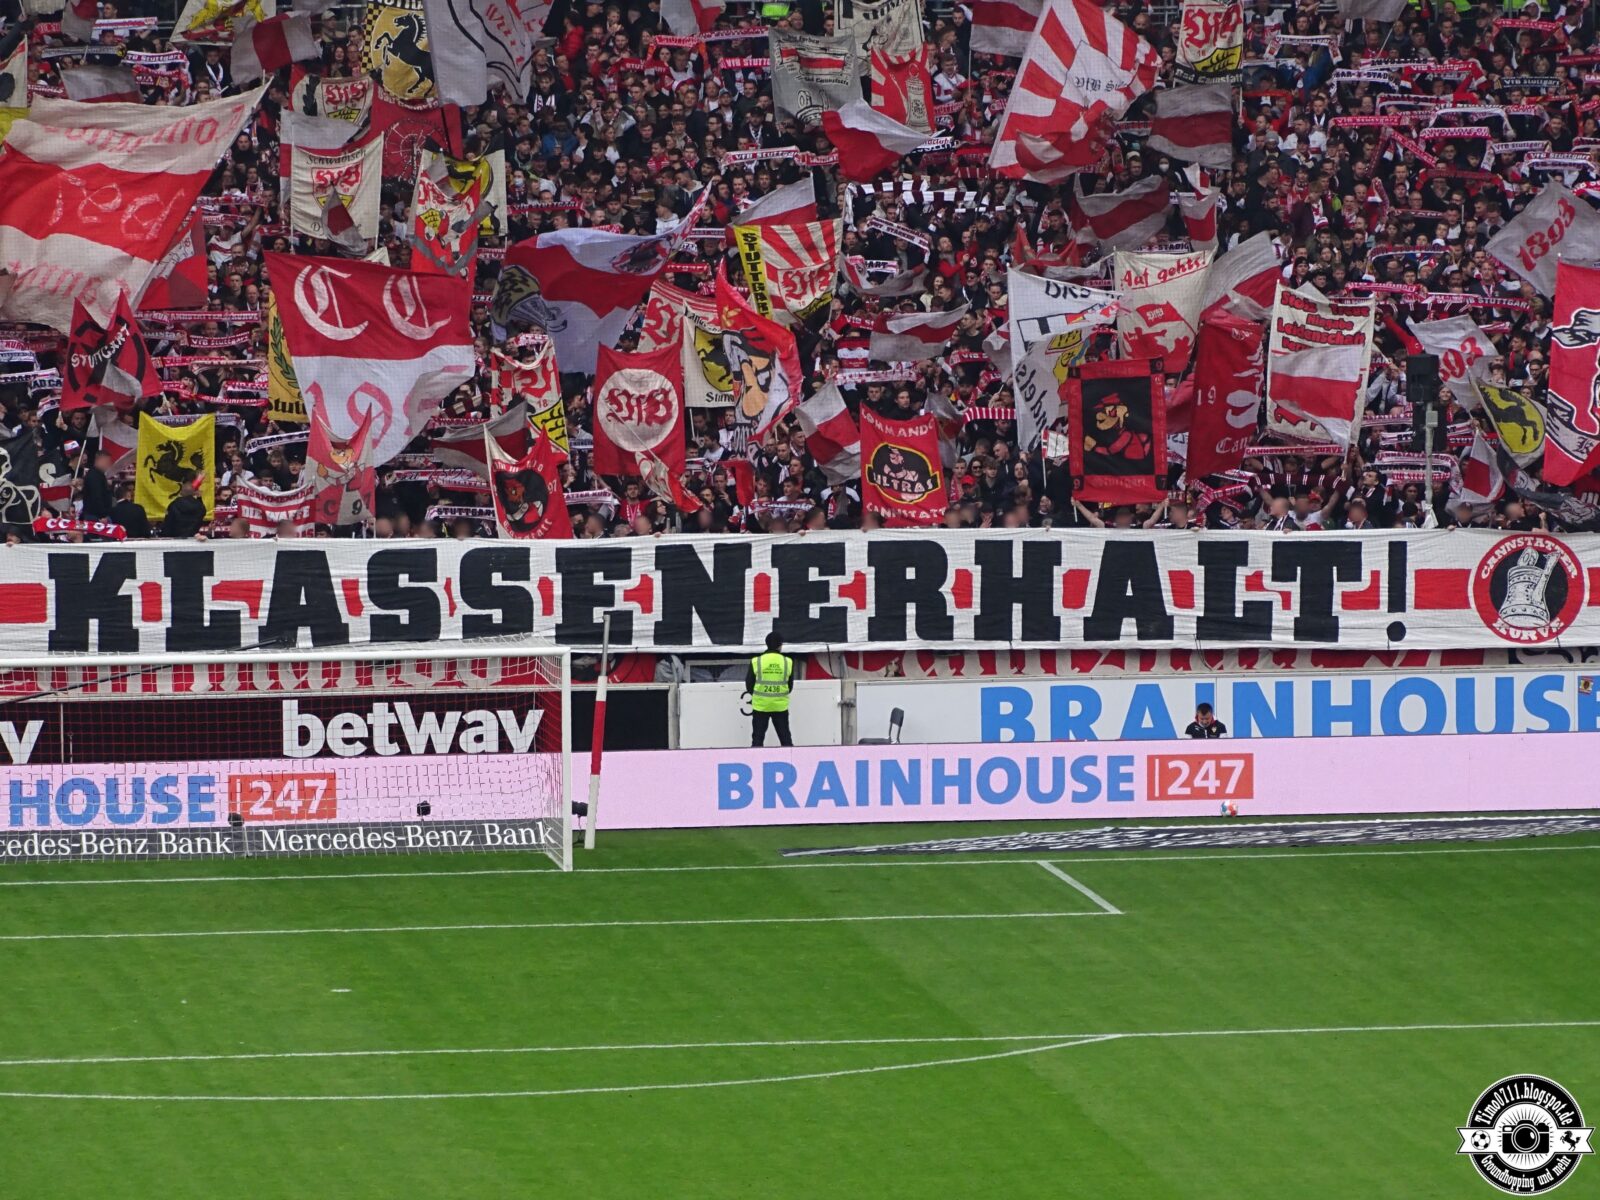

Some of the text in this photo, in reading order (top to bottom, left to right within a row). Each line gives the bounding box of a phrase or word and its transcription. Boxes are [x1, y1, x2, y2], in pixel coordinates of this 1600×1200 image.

[1522, 78, 1560, 88] Stuttgart
[1122, 250, 1207, 288] Auf gehts!
[1276, 317, 1367, 346] Leidenschaft
[873, 469, 933, 493] ULTRAS
[1481, 535, 1579, 580] CANNSTATTER
[47, 540, 1408, 653] KLASSENERHALT!
[1492, 616, 1565, 641] KURVE
[282, 699, 545, 758] betway
[9, 775, 328, 827] HOUSE 247
[717, 754, 1247, 811] BRAINHOUSE 247
[158, 829, 233, 855] Bank
[259, 825, 474, 852] Mercedes-Benz
[484, 821, 557, 847] Bank
